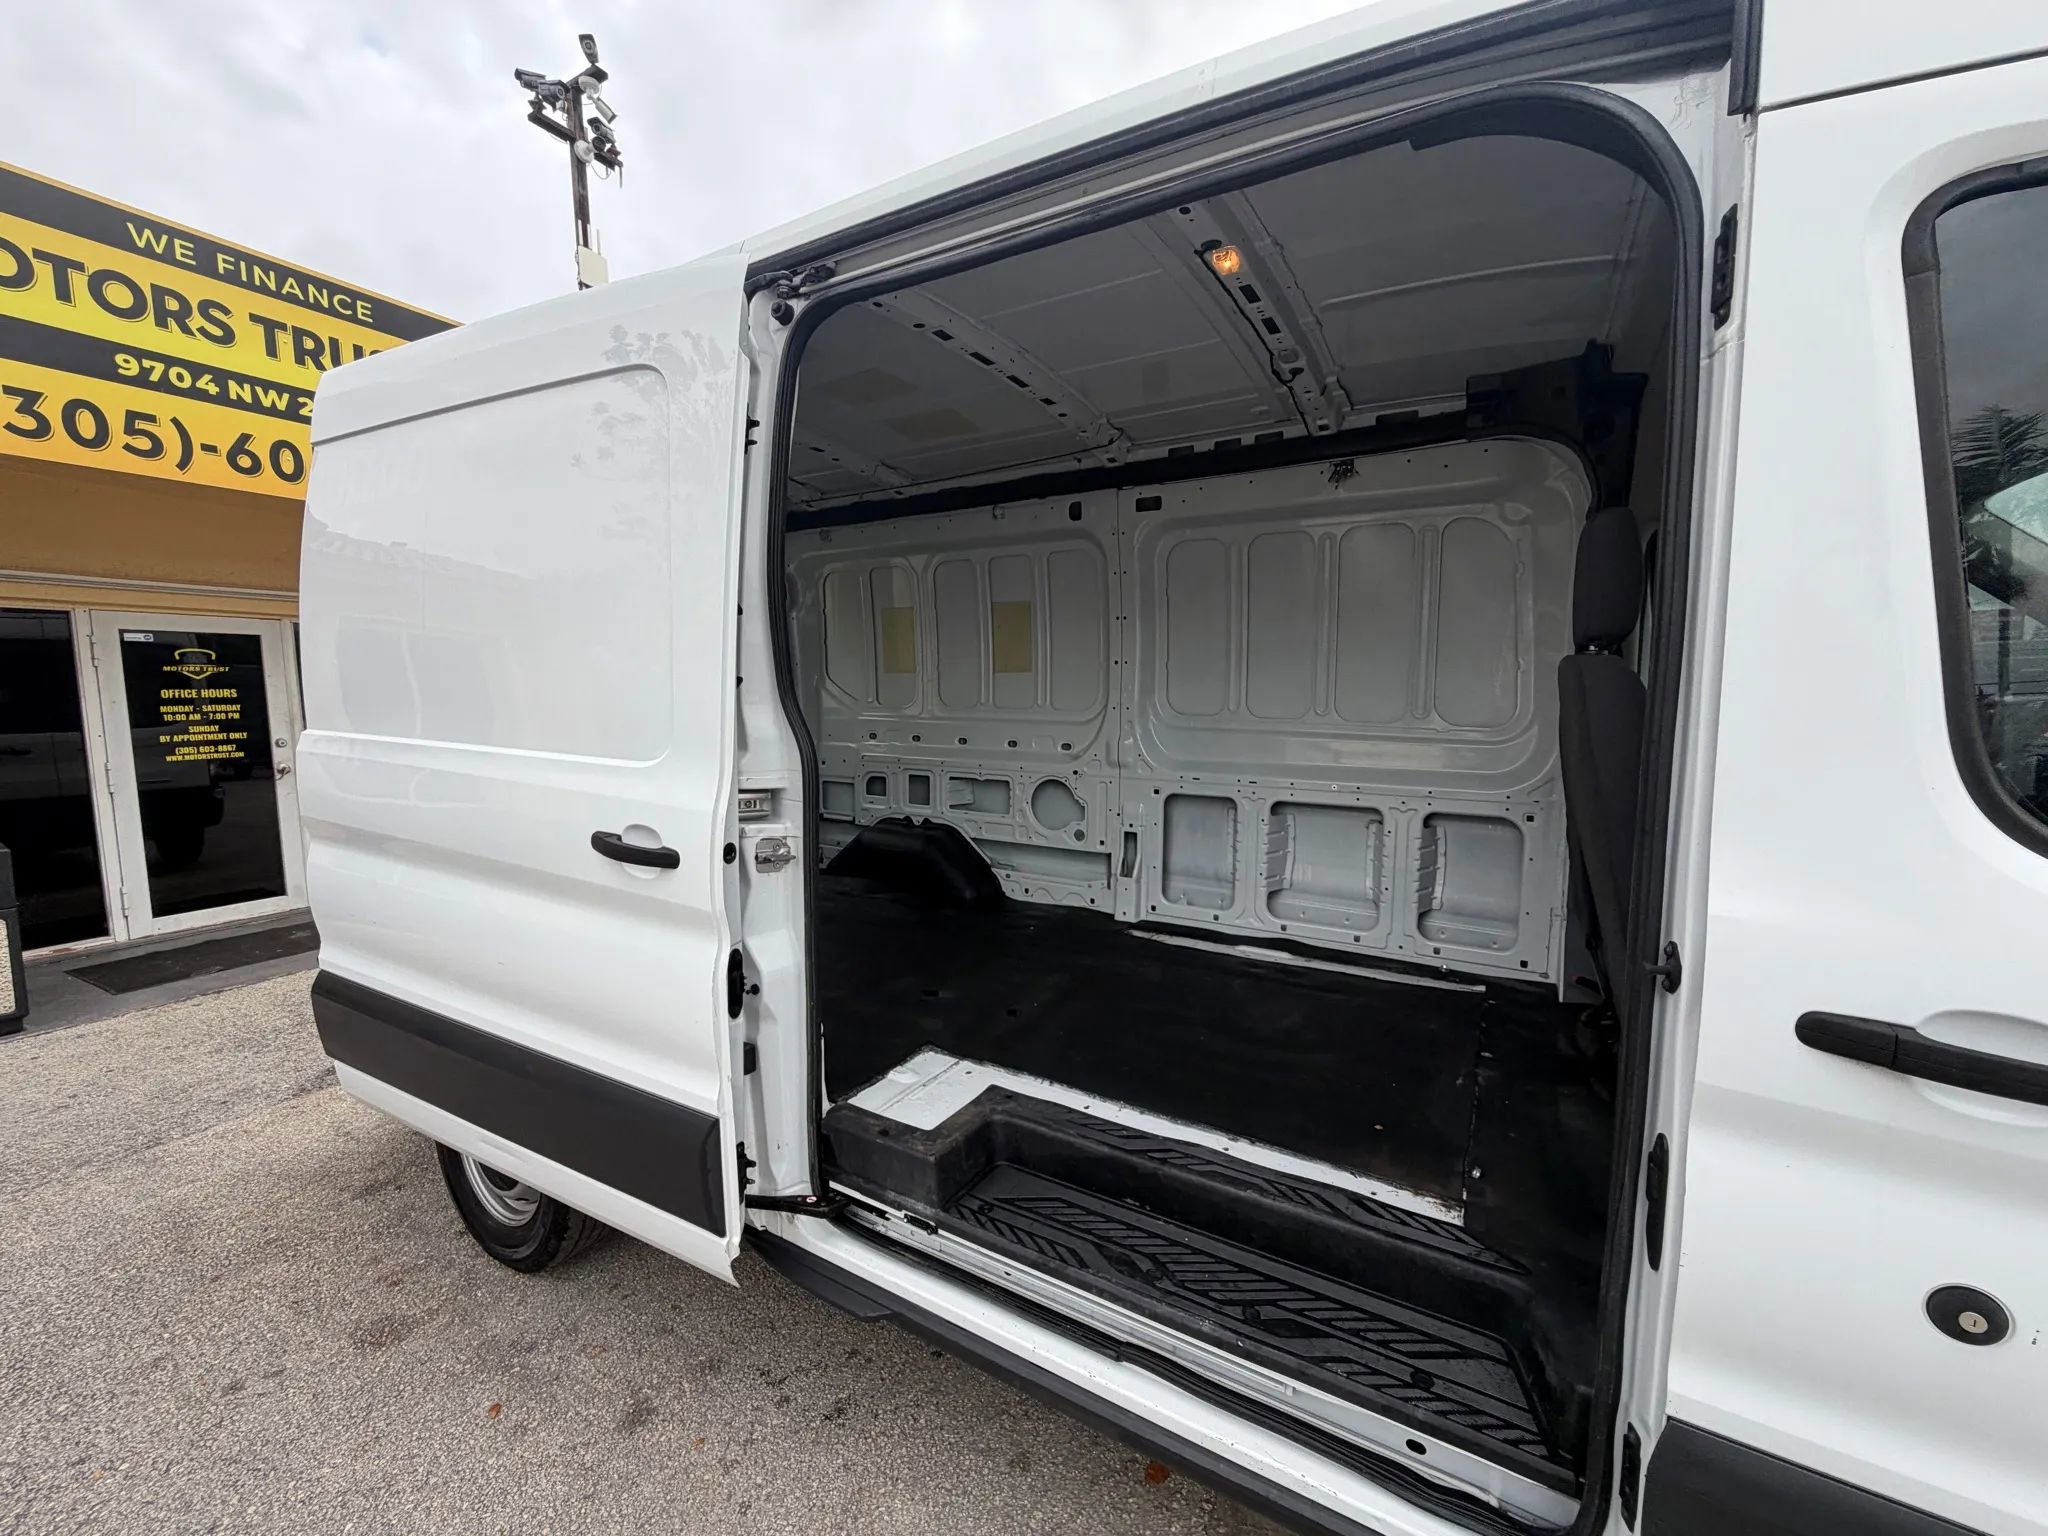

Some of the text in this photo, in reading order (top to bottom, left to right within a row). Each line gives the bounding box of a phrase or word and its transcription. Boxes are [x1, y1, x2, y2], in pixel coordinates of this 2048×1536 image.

[126, 222, 375, 323] WE FINANCE
[248, 312, 383, 372] TRU
[114, 353, 314, 417] 9704 NW 2
[1, 384, 307, 485] 305)-60
[160, 688, 238, 699] OFFICE HOURS
[160, 705, 194, 713] MONDAY
[202, 704, 241, 712] SATURDAY
[189, 713, 202, 721] AM
[209, 712, 227, 720] 7:00
[228, 712, 241, 720] PM
[188, 725, 219, 733] SUNDAY
[160, 731, 248, 743] BY APPOINTMENT ONLY
[175, 746, 198, 756] (305)
